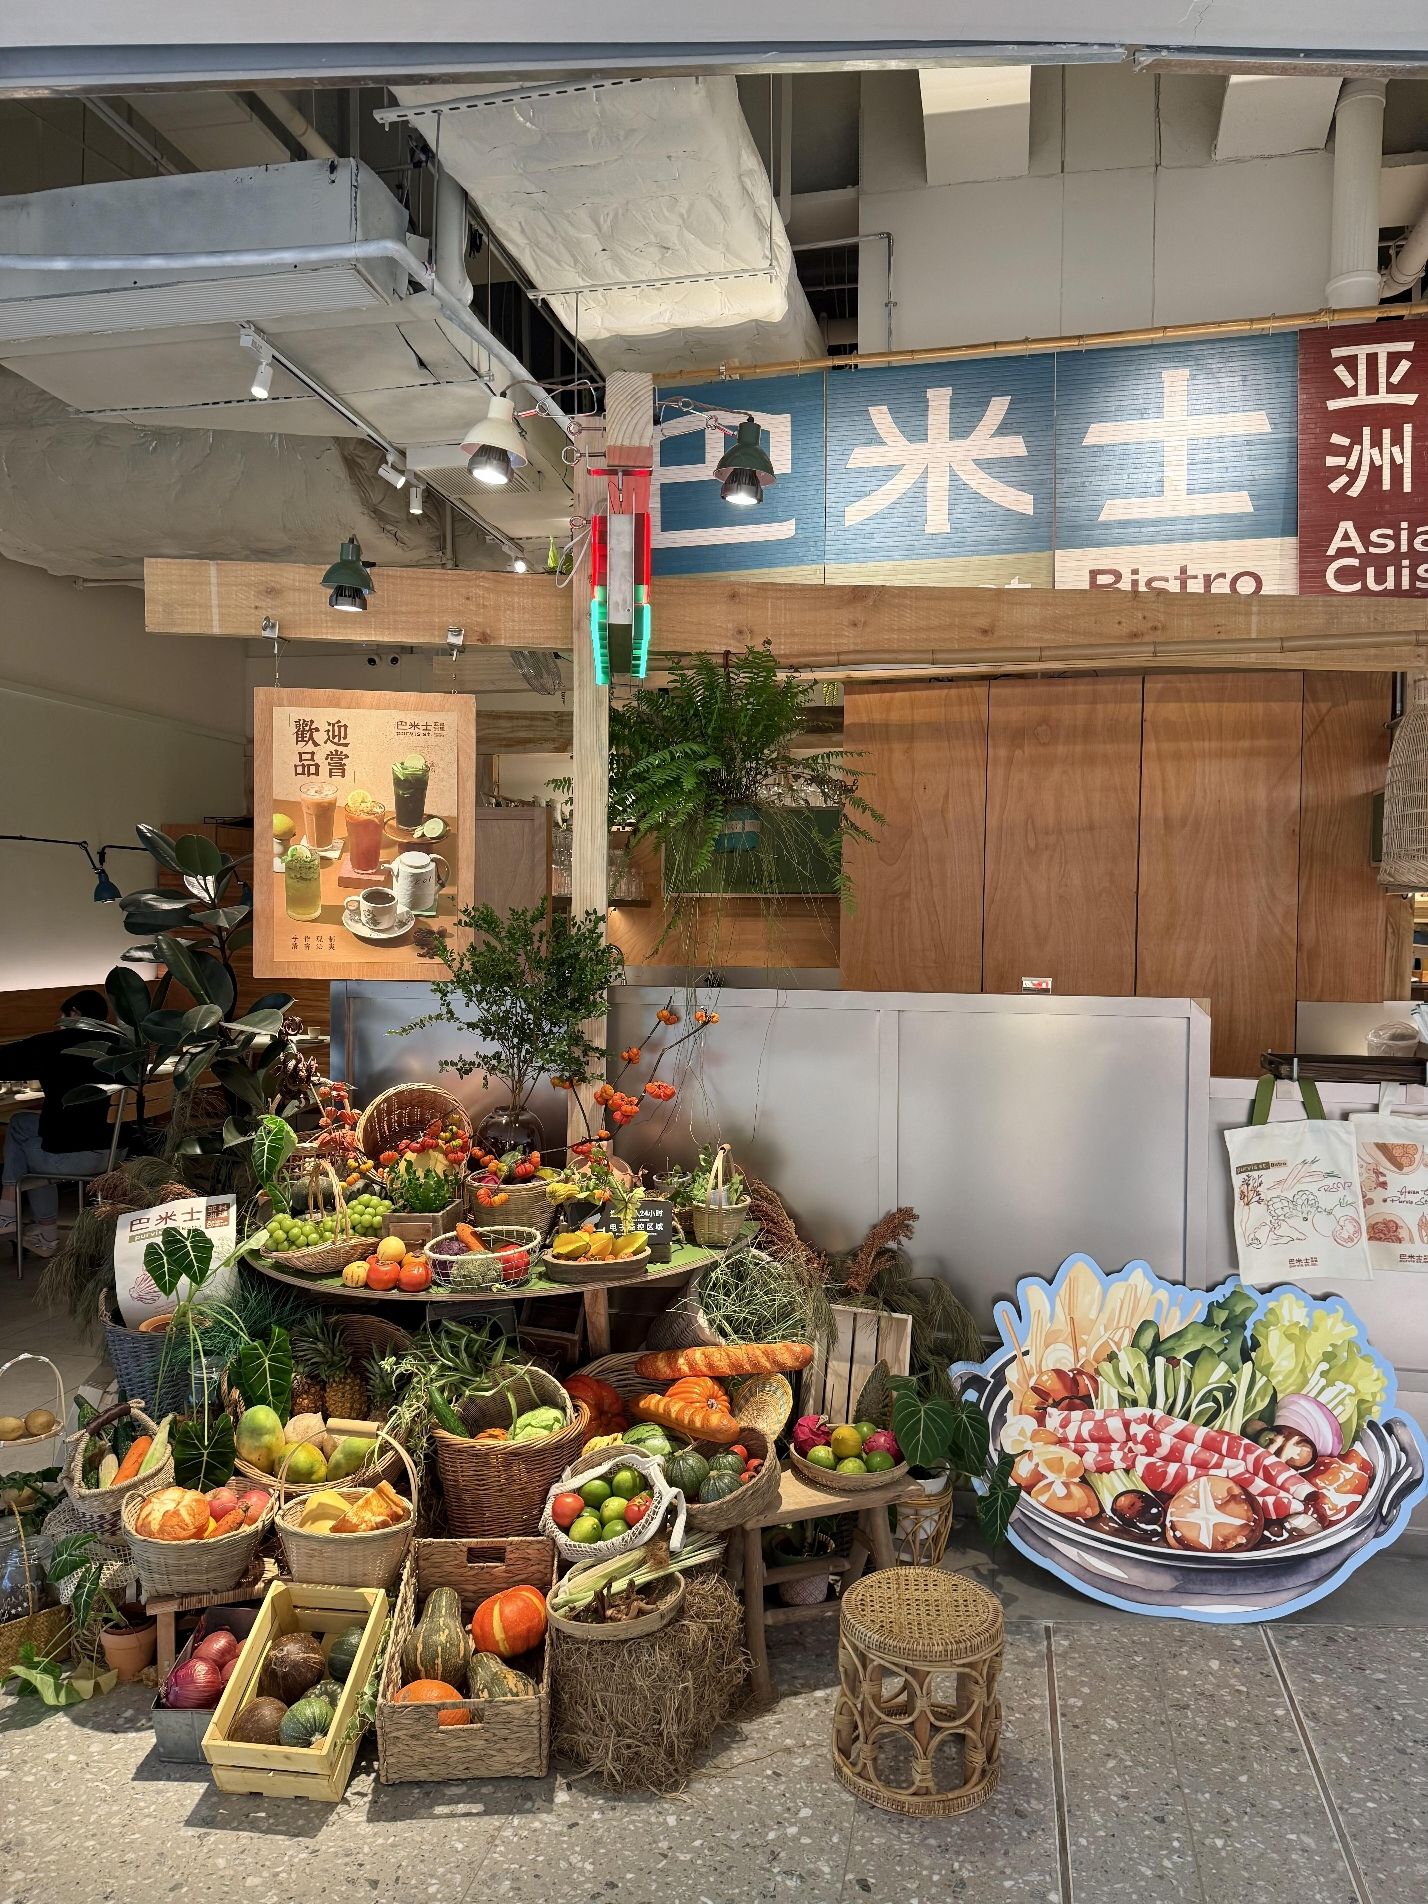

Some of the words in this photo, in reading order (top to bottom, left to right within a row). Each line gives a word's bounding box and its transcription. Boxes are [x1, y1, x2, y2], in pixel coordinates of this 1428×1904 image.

[651, 368, 1272, 549] 巴米士
[1326, 341, 1419, 497] 亚洲
[130, 1206, 203, 1233] 巴米士
